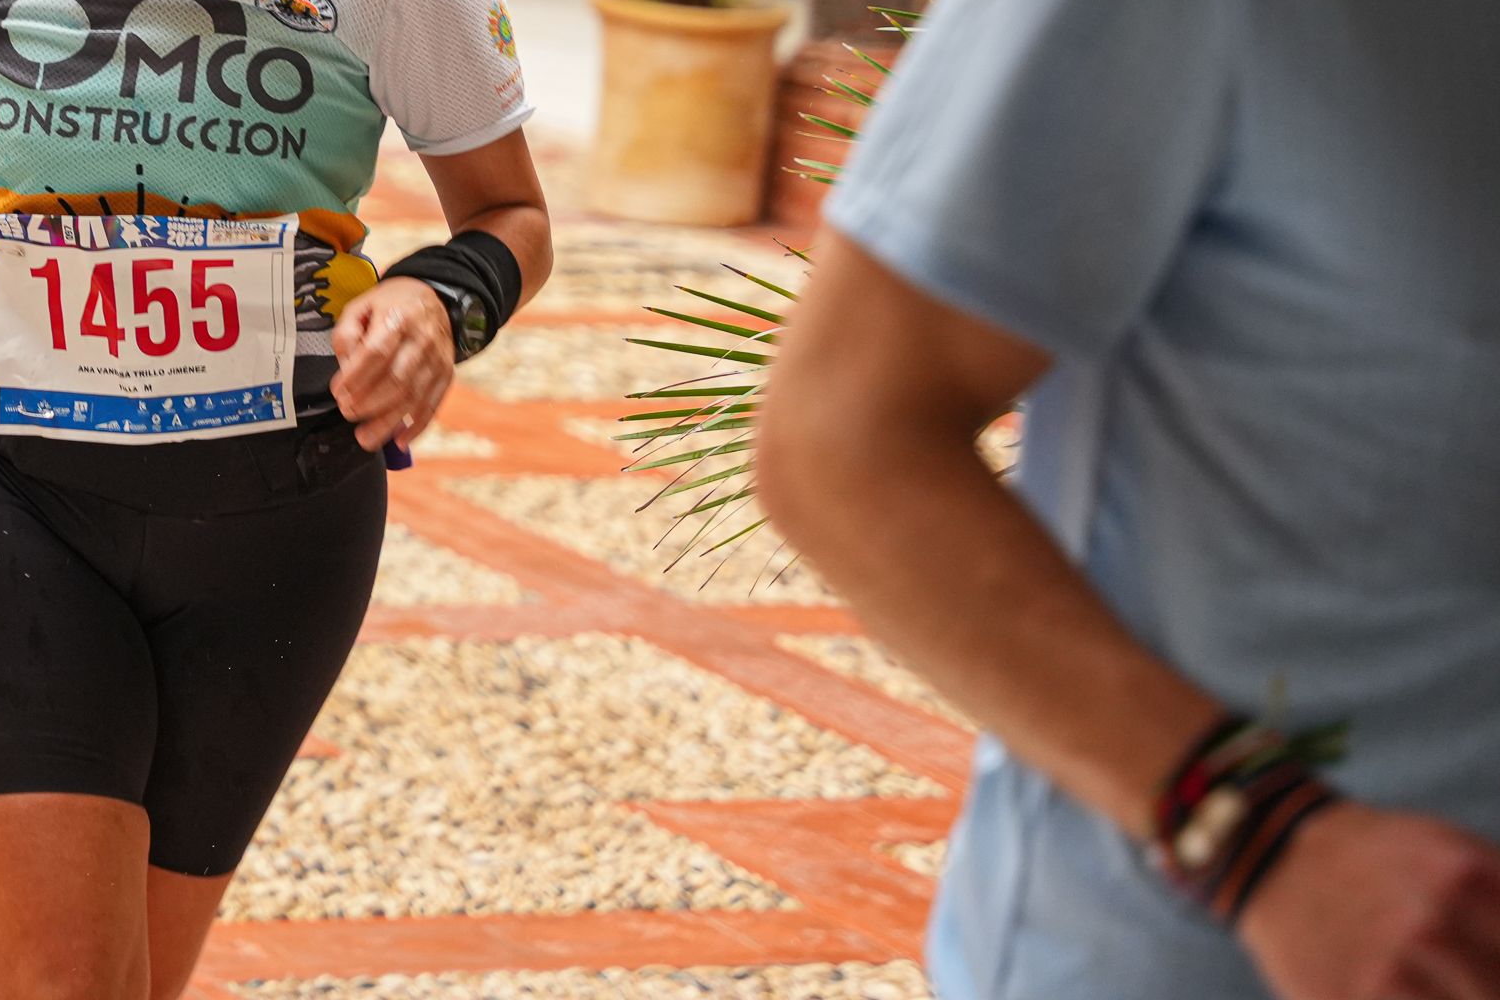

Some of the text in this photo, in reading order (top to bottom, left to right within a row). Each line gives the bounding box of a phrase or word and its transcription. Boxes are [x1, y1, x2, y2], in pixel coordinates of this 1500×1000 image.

[166, 231, 204, 247] 2026
[30, 258, 240, 358] 1455
[78, 365, 95, 375] ANA
[133, 368, 166, 379] TRILLO
[143, 384, 153, 393] M
